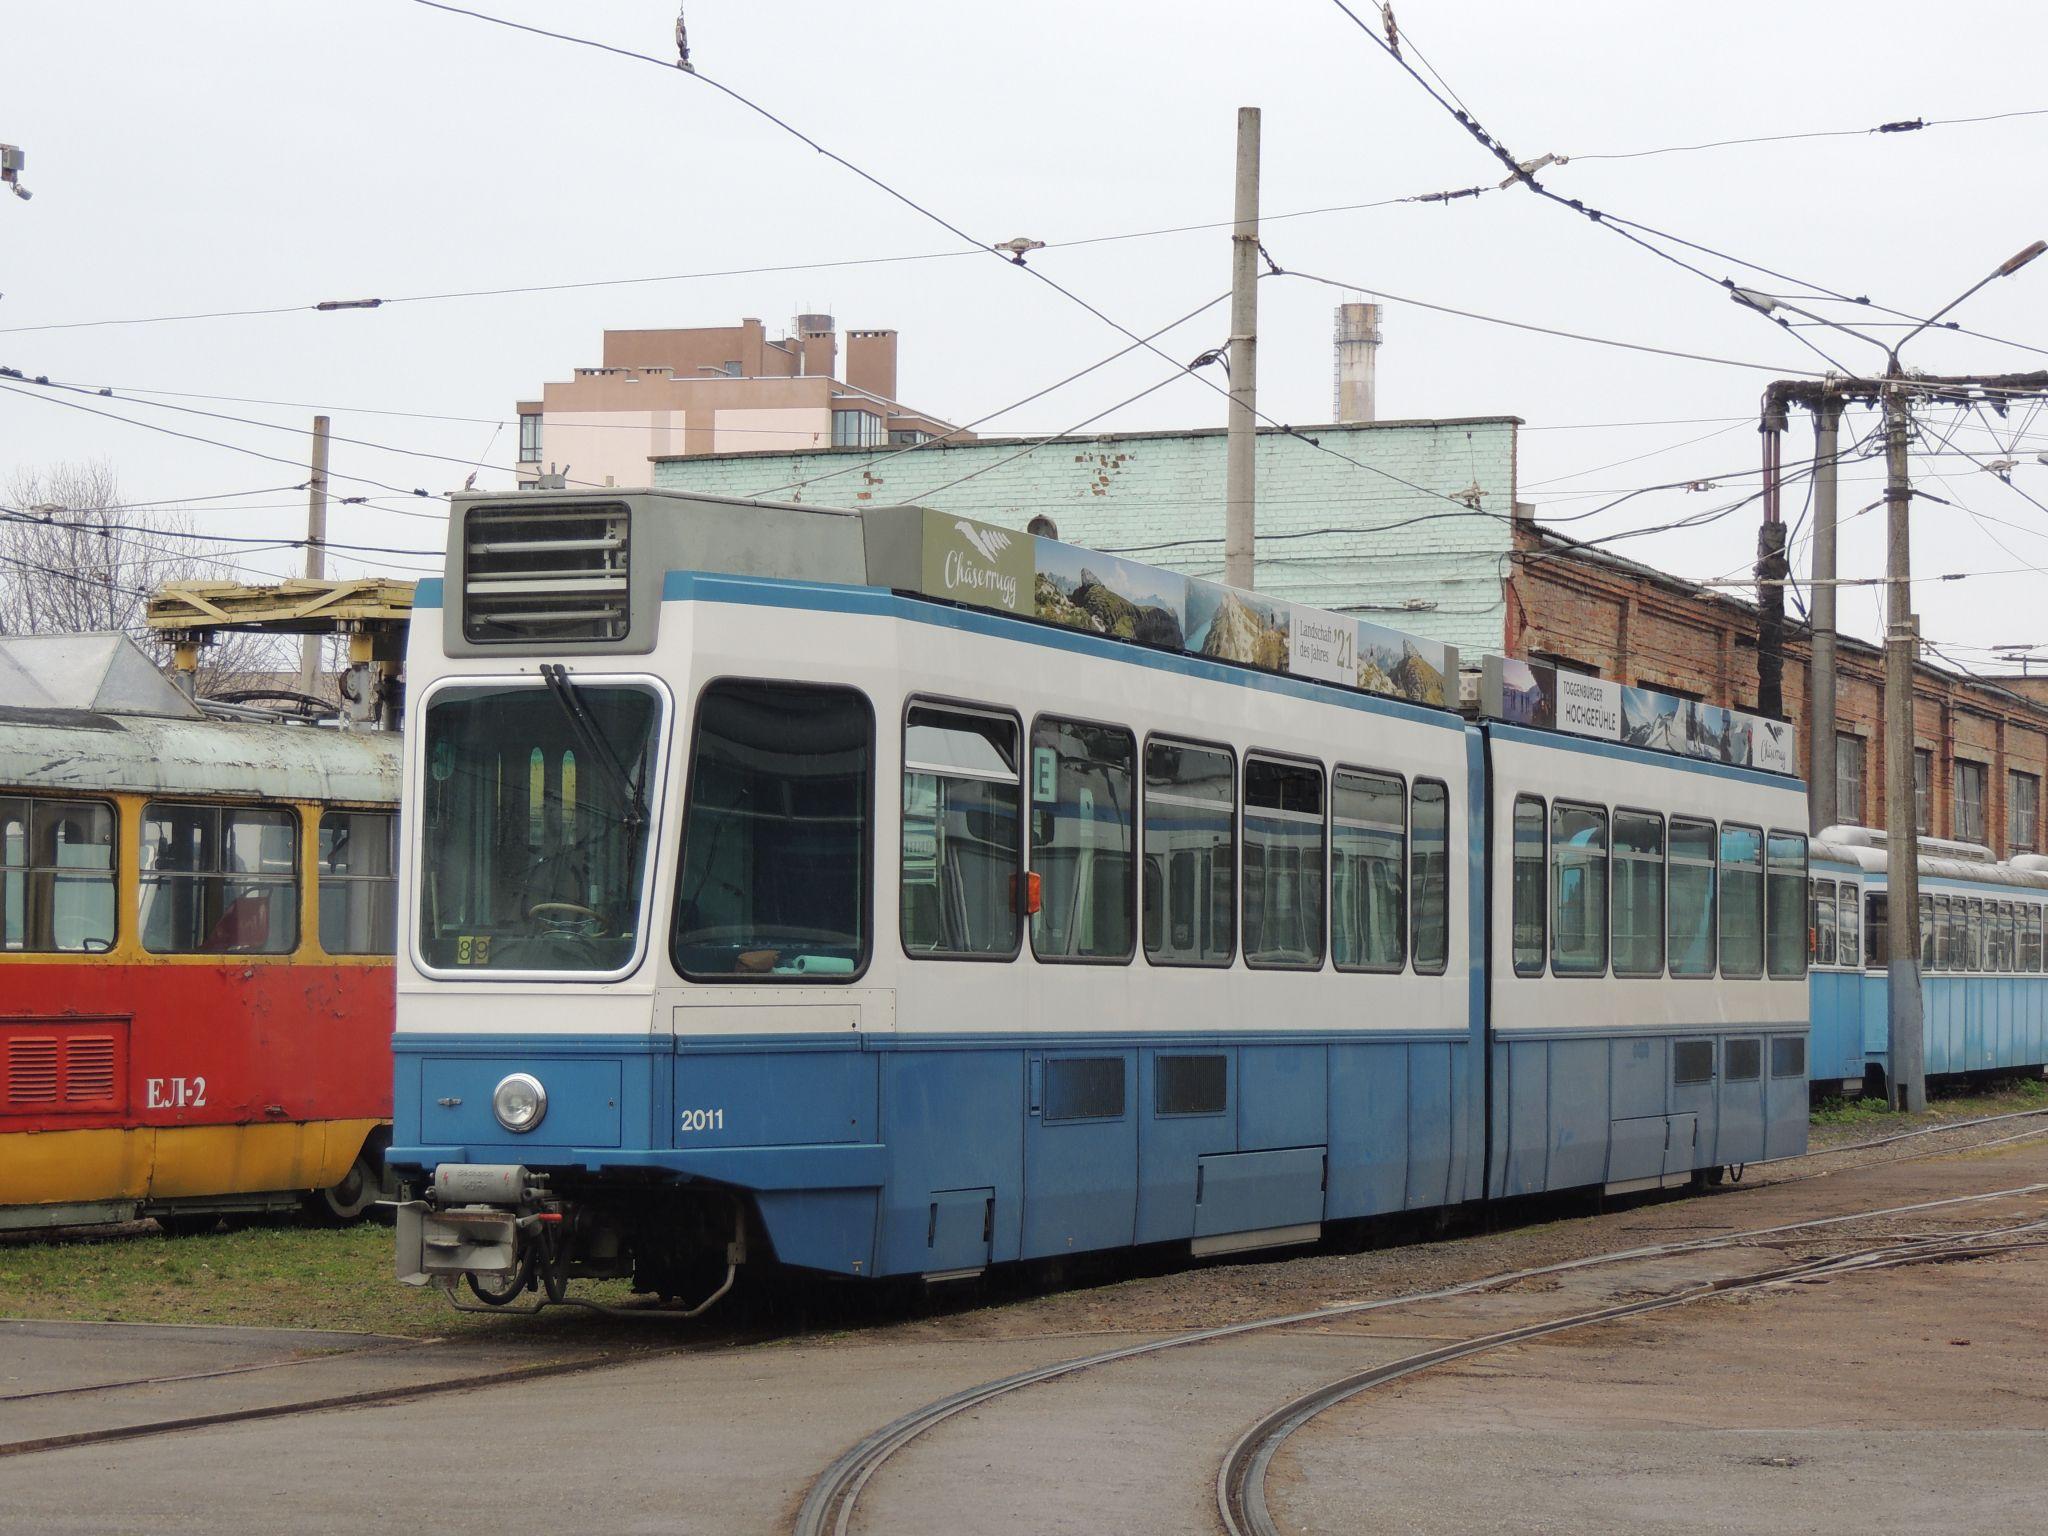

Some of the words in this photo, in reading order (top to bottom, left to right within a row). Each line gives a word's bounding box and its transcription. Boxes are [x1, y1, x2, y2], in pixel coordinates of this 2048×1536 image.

[944, 550, 1017, 609] Chäserrugg
[1300, 620, 1332, 643] Landschaft
[1300, 641, 1310, 659] des
[1563, 680, 1603, 702] TOGGENBURGER
[1039, 757, 1050, 795] E
[146, 1076, 207, 1109] ЕЛ-2
[681, 1108, 723, 1131] 2011
